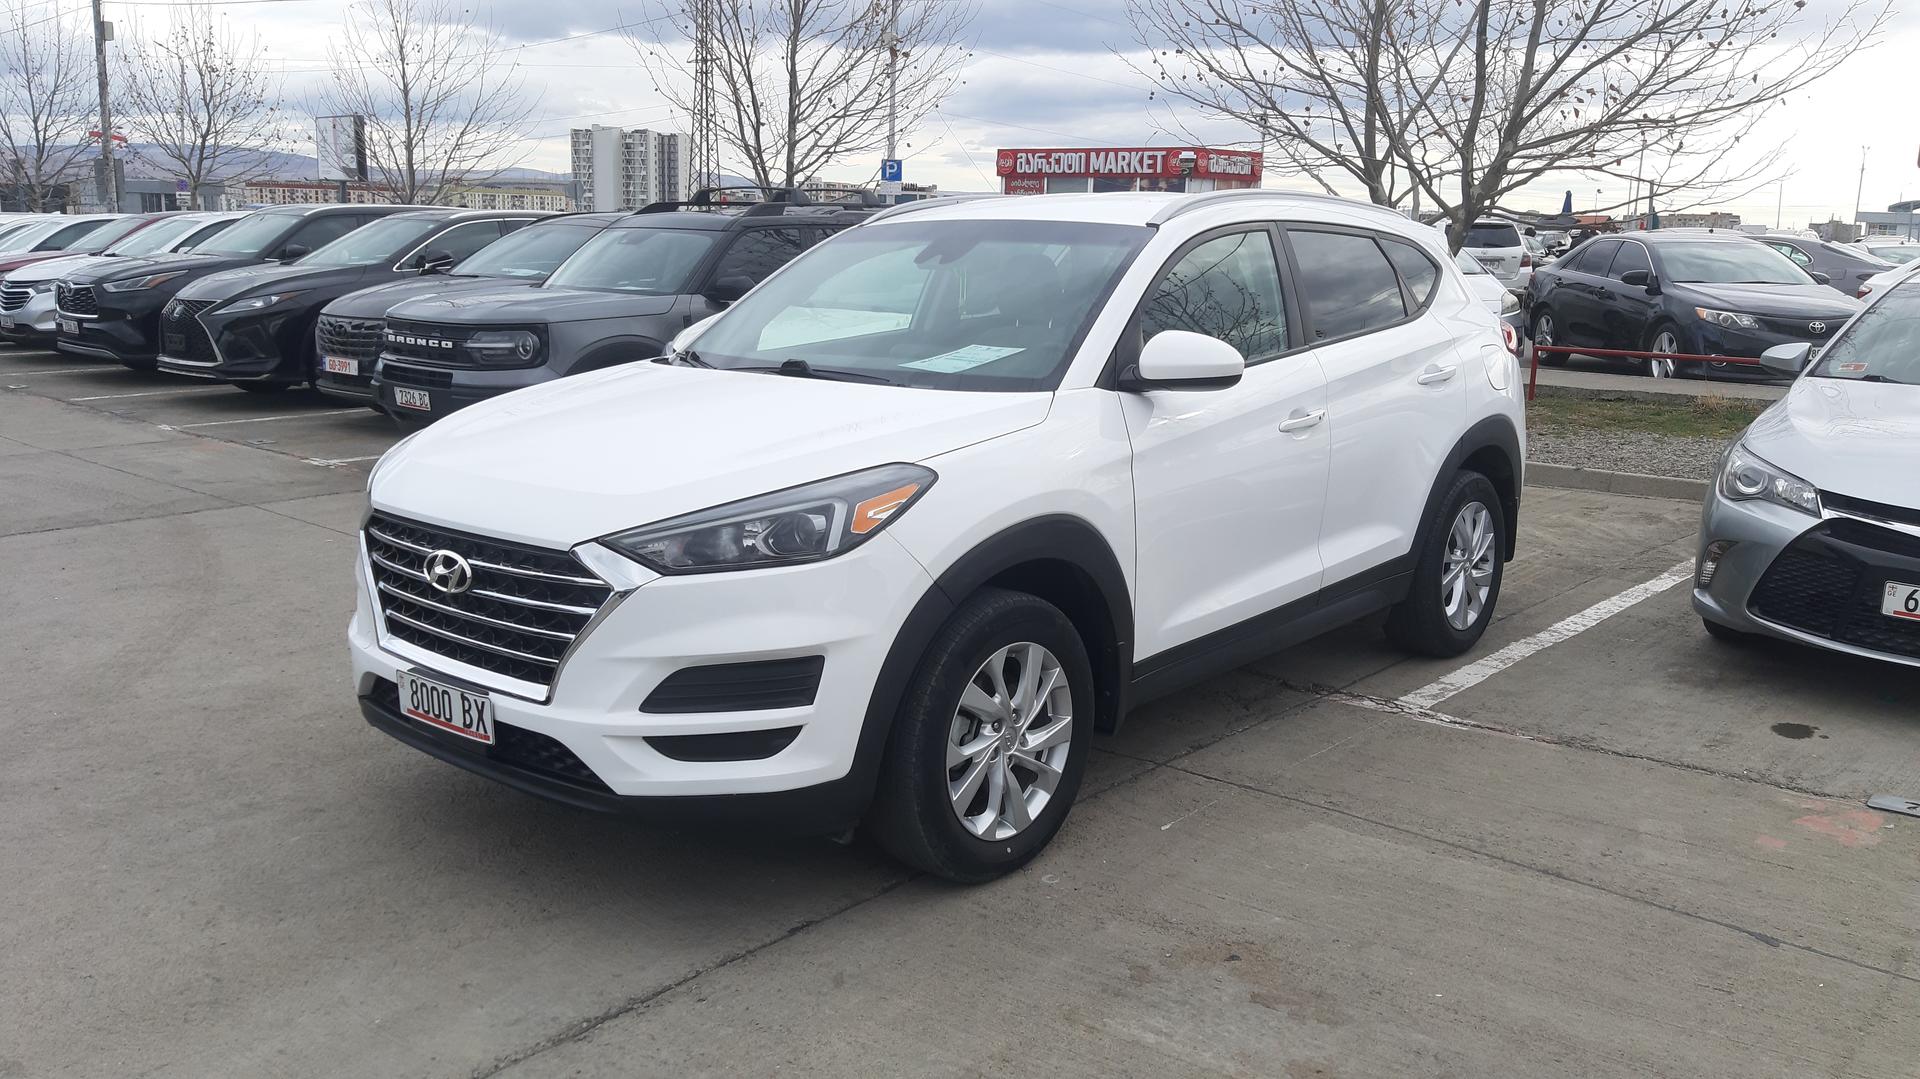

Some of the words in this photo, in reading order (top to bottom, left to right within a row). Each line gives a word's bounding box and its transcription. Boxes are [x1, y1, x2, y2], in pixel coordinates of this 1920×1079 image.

[886, 161, 898, 179] P
[1089, 151, 1167, 174] MARKET
[388, 334, 453, 349] BRONCO
[409, 678, 453, 723] 8000
[460, 691, 488, 735] BX
